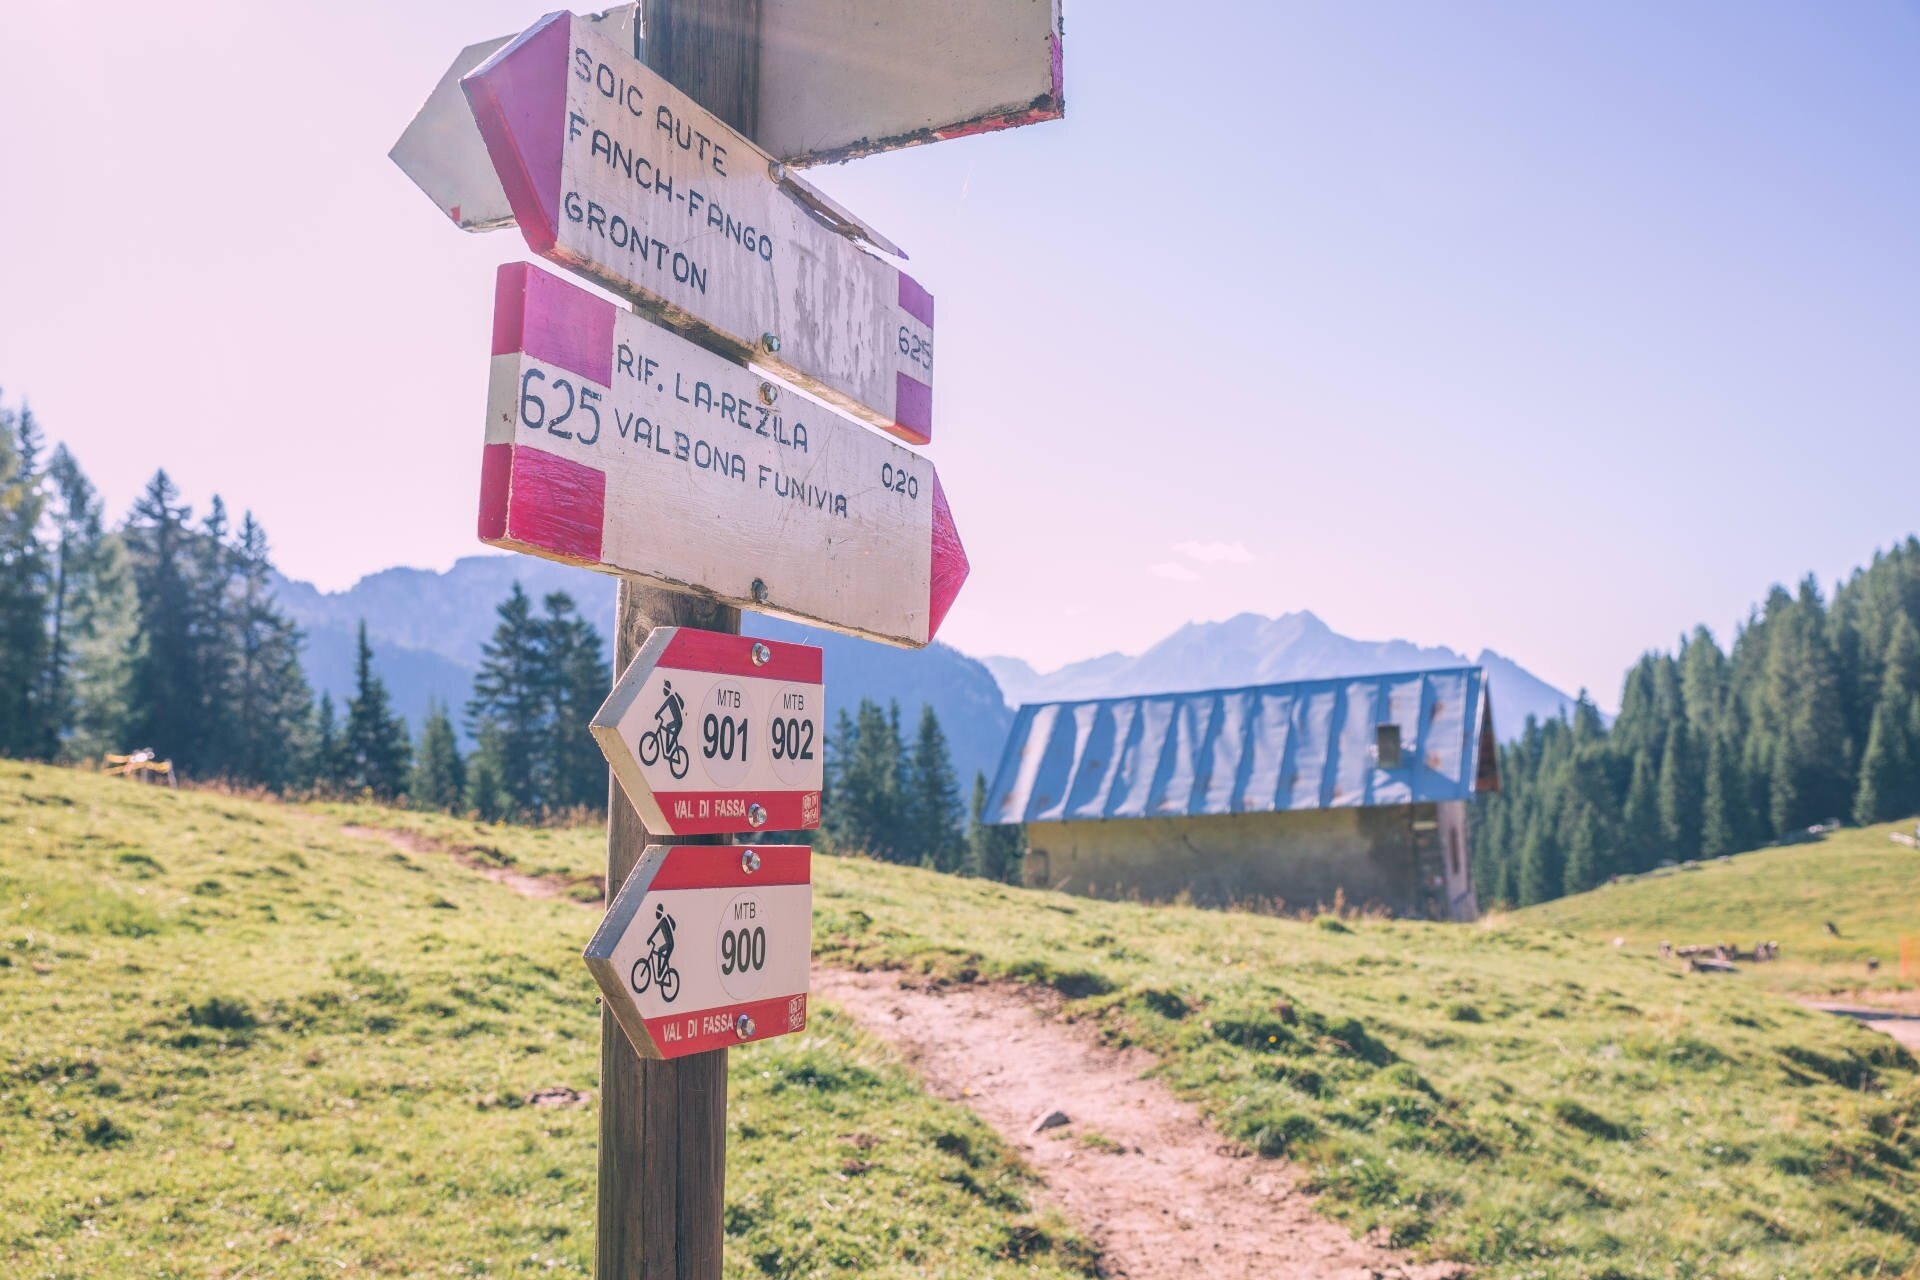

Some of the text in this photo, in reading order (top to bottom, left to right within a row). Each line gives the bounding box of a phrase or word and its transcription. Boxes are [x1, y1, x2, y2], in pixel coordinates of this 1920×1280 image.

[575, 47, 727, 178] SOIC AUTE
[569, 111, 773, 262] FANCH-FANGO
[564, 191, 707, 295] GRONTON
[899, 326, 933, 370] 625
[520, 368, 601, 446] 625
[617, 344, 808, 454] RIF. LA-REZILA
[615, 408, 847, 518] VALBONA FUNIVIA
[717, 688, 741, 709] MTB
[783, 693, 804, 711] MTB
[703, 713, 748, 762] 901
[772, 717, 814, 760] 902
[674, 799, 747, 819] VAL DI FASSA
[734, 902, 756, 920] MTB
[721, 926, 766, 976] 900
[662, 1013, 734, 1042] VAL DI FASSA
